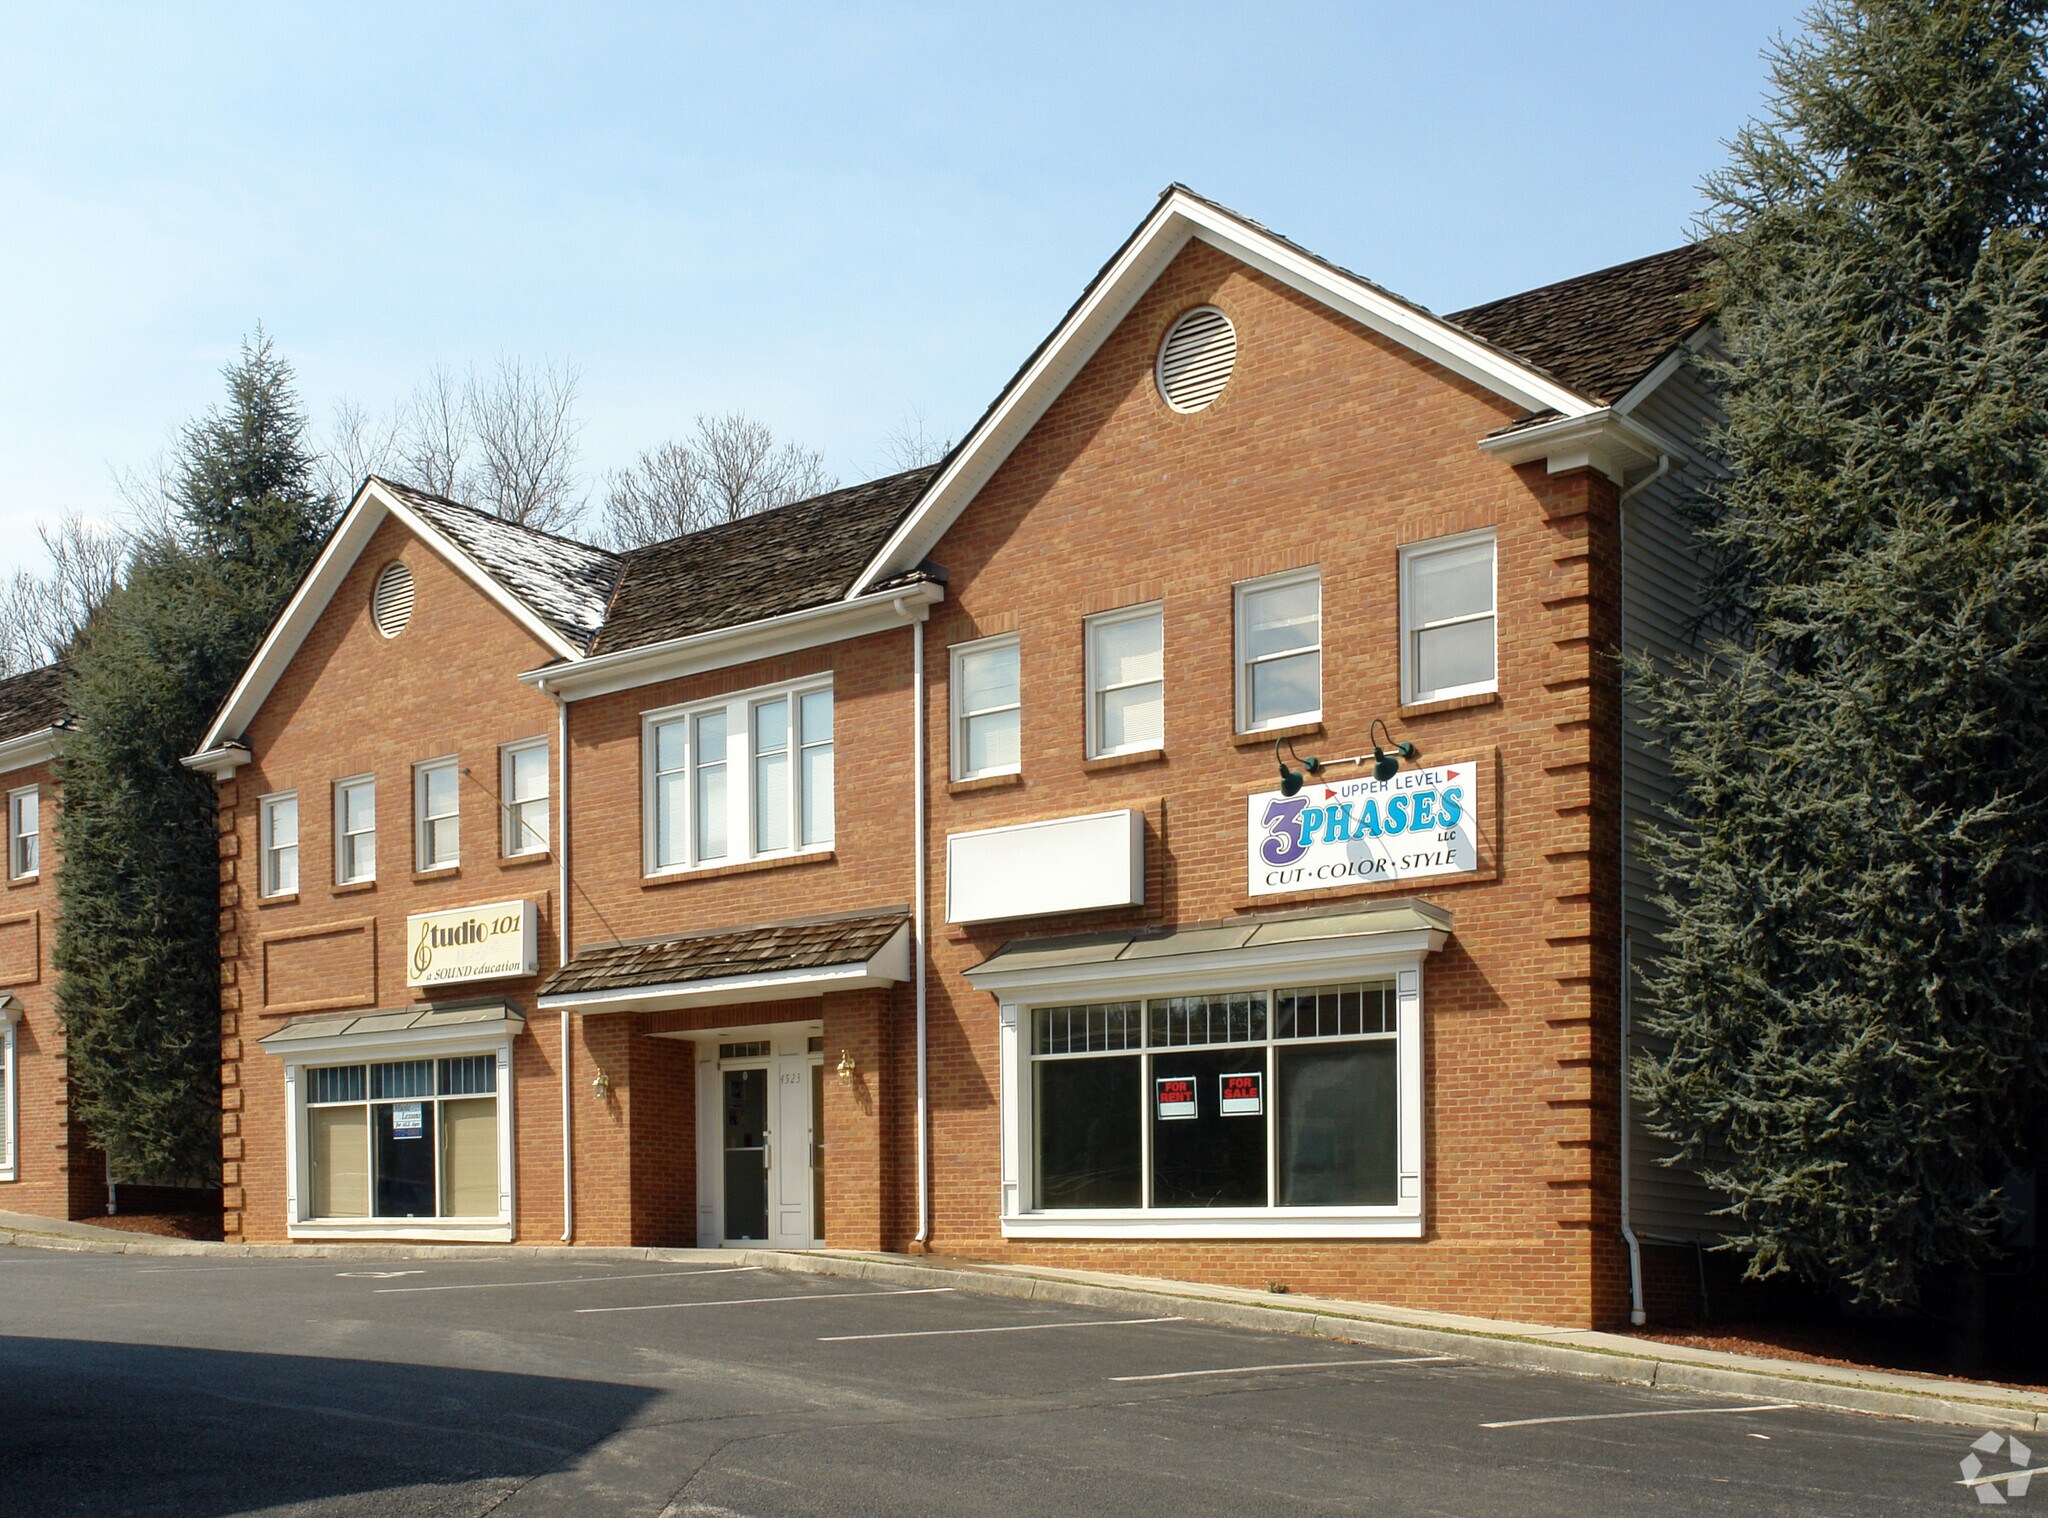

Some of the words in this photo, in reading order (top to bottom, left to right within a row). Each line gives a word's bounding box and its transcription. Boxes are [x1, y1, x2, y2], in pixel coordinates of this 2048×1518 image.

[1341, 779, 1388, 798] UPPER
[1395, 772, 1443, 790] LEVEL
[1437, 830, 1457, 843] LLC
[1265, 867, 1306, 886] CUT
[1316, 858, 1388, 880] COLOR
[1400, 849, 1458, 871] STYLE
[490, 914, 521, 936] 101
[434, 965, 473, 981] SOUND
[473, 960, 521, 976] education
[1164, 1081, 1188, 1092] FOR
[1228, 1077, 1252, 1089] FOR
[1160, 1091, 1193, 1103] RENT
[1223, 1087, 1258, 1099] SALE
